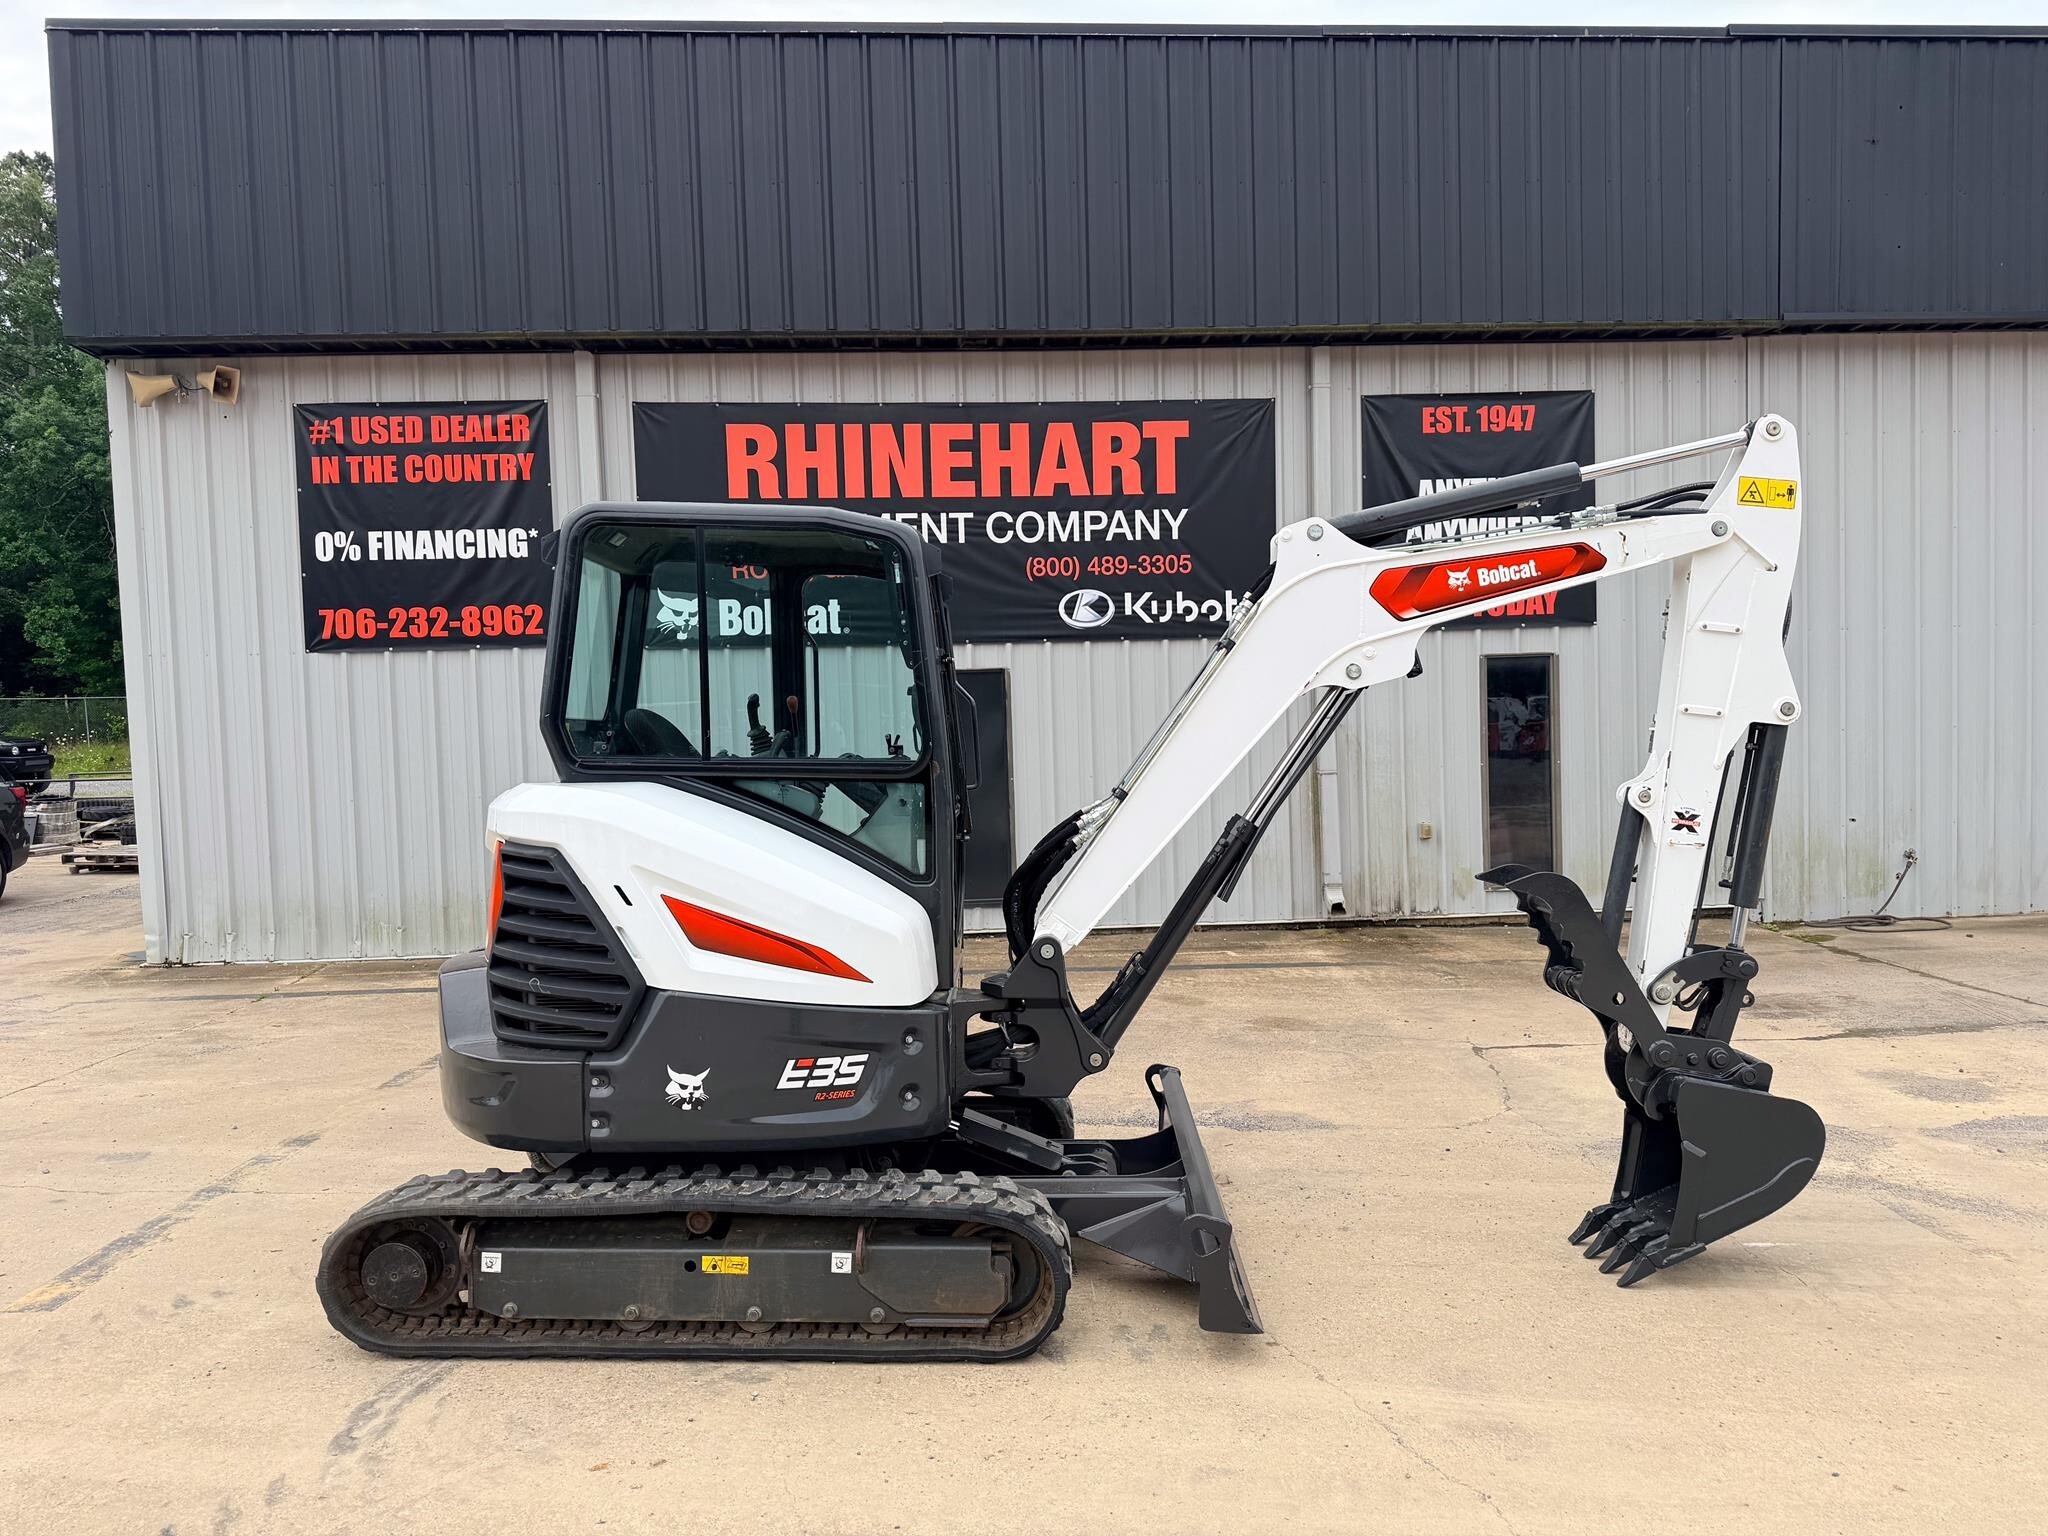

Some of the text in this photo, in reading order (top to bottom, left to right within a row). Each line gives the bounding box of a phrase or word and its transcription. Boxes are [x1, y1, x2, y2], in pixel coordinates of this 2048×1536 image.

[309, 414, 531, 445] #1 USED DEALER
[1422, 405, 1536, 434] EST. 1947
[311, 452, 535, 484] IN THE COUNTRY
[725, 420, 1190, 500] RHINEHART
[985, 508, 1189, 544] COMPANY
[314, 530, 362, 562] 0%
[1026, 554, 1193, 582] (800) 489-3305
[1476, 559, 1538, 587] Bobcat
[318, 604, 544, 640] 706-232-8962
[776, 1053, 869, 1090] E35
[815, 1089, 856, 1101] R2-SERIES
